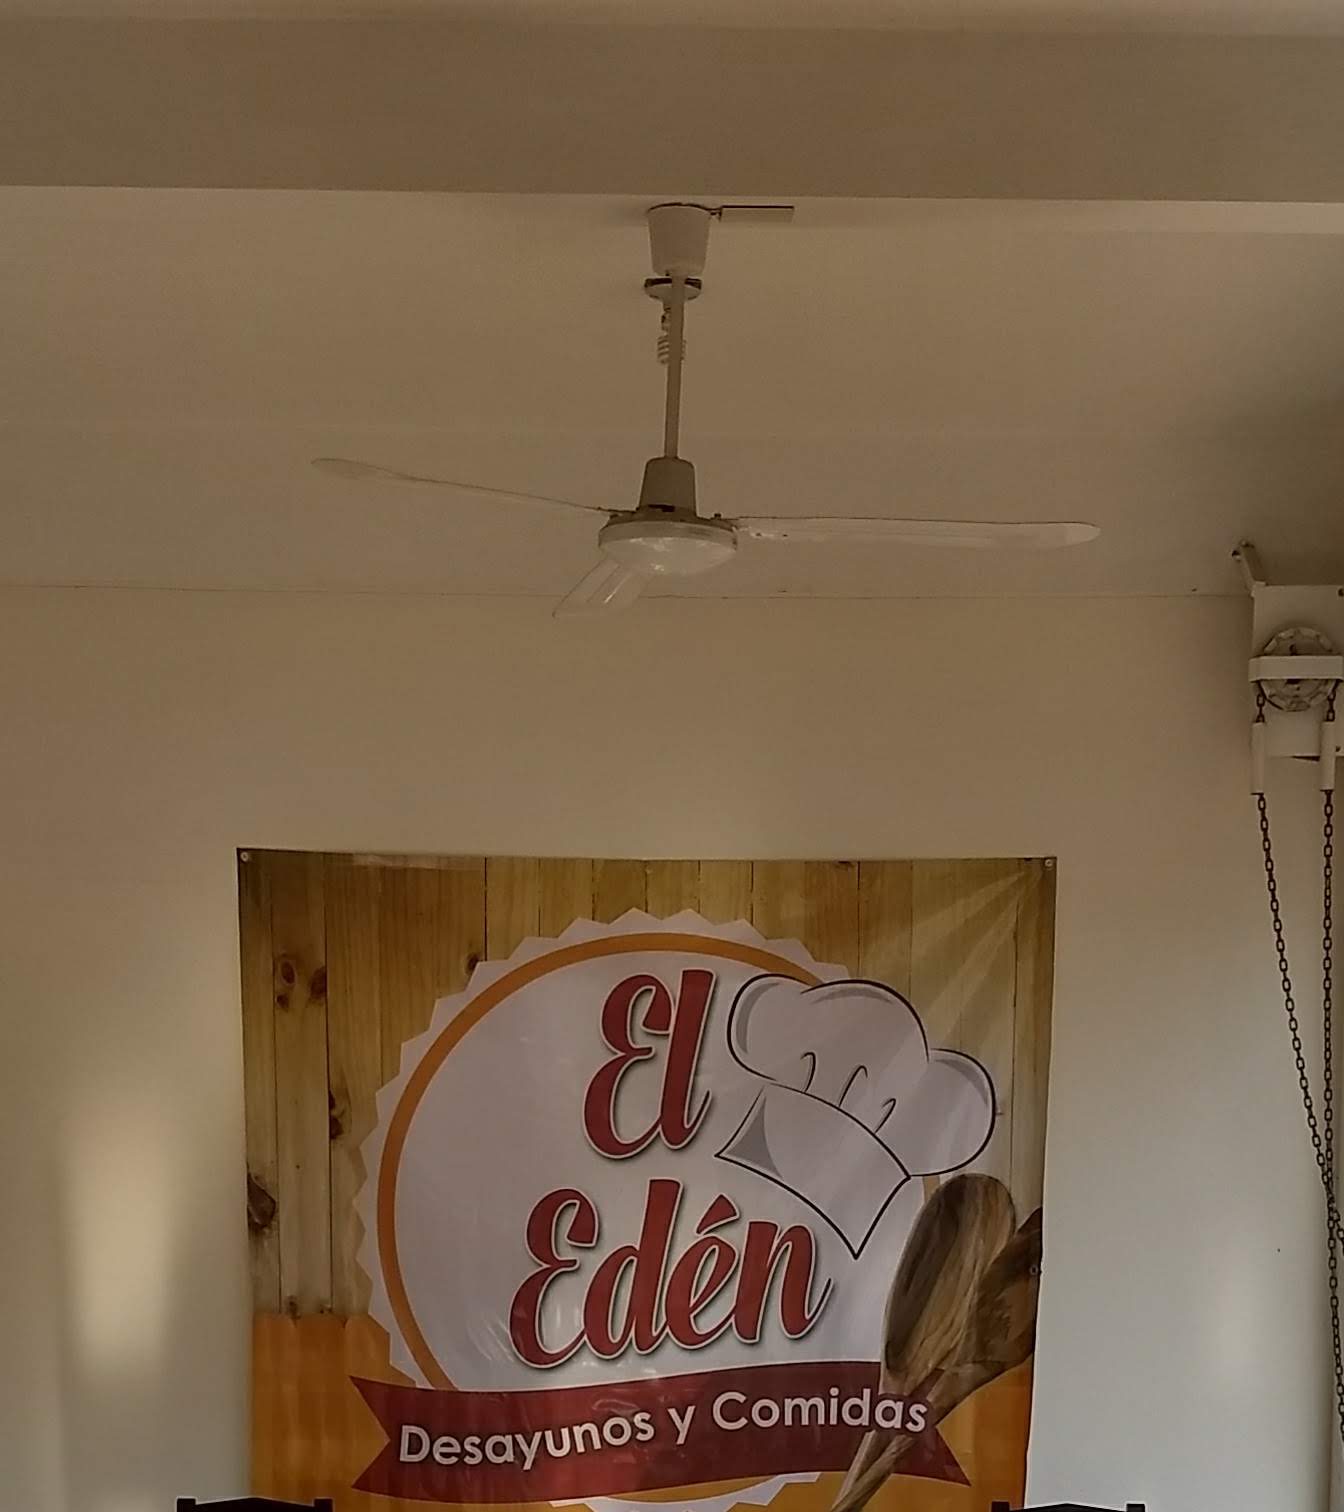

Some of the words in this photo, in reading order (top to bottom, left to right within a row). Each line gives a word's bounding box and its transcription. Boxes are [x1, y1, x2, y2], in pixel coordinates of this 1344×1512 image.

[583, 967, 716, 1160] El
[508, 1179, 832, 1370] Edén
[399, 1411, 655, 1470] Desayunos
[668, 1404, 696, 1446] y
[711, 1389, 929, 1434] Comidas
